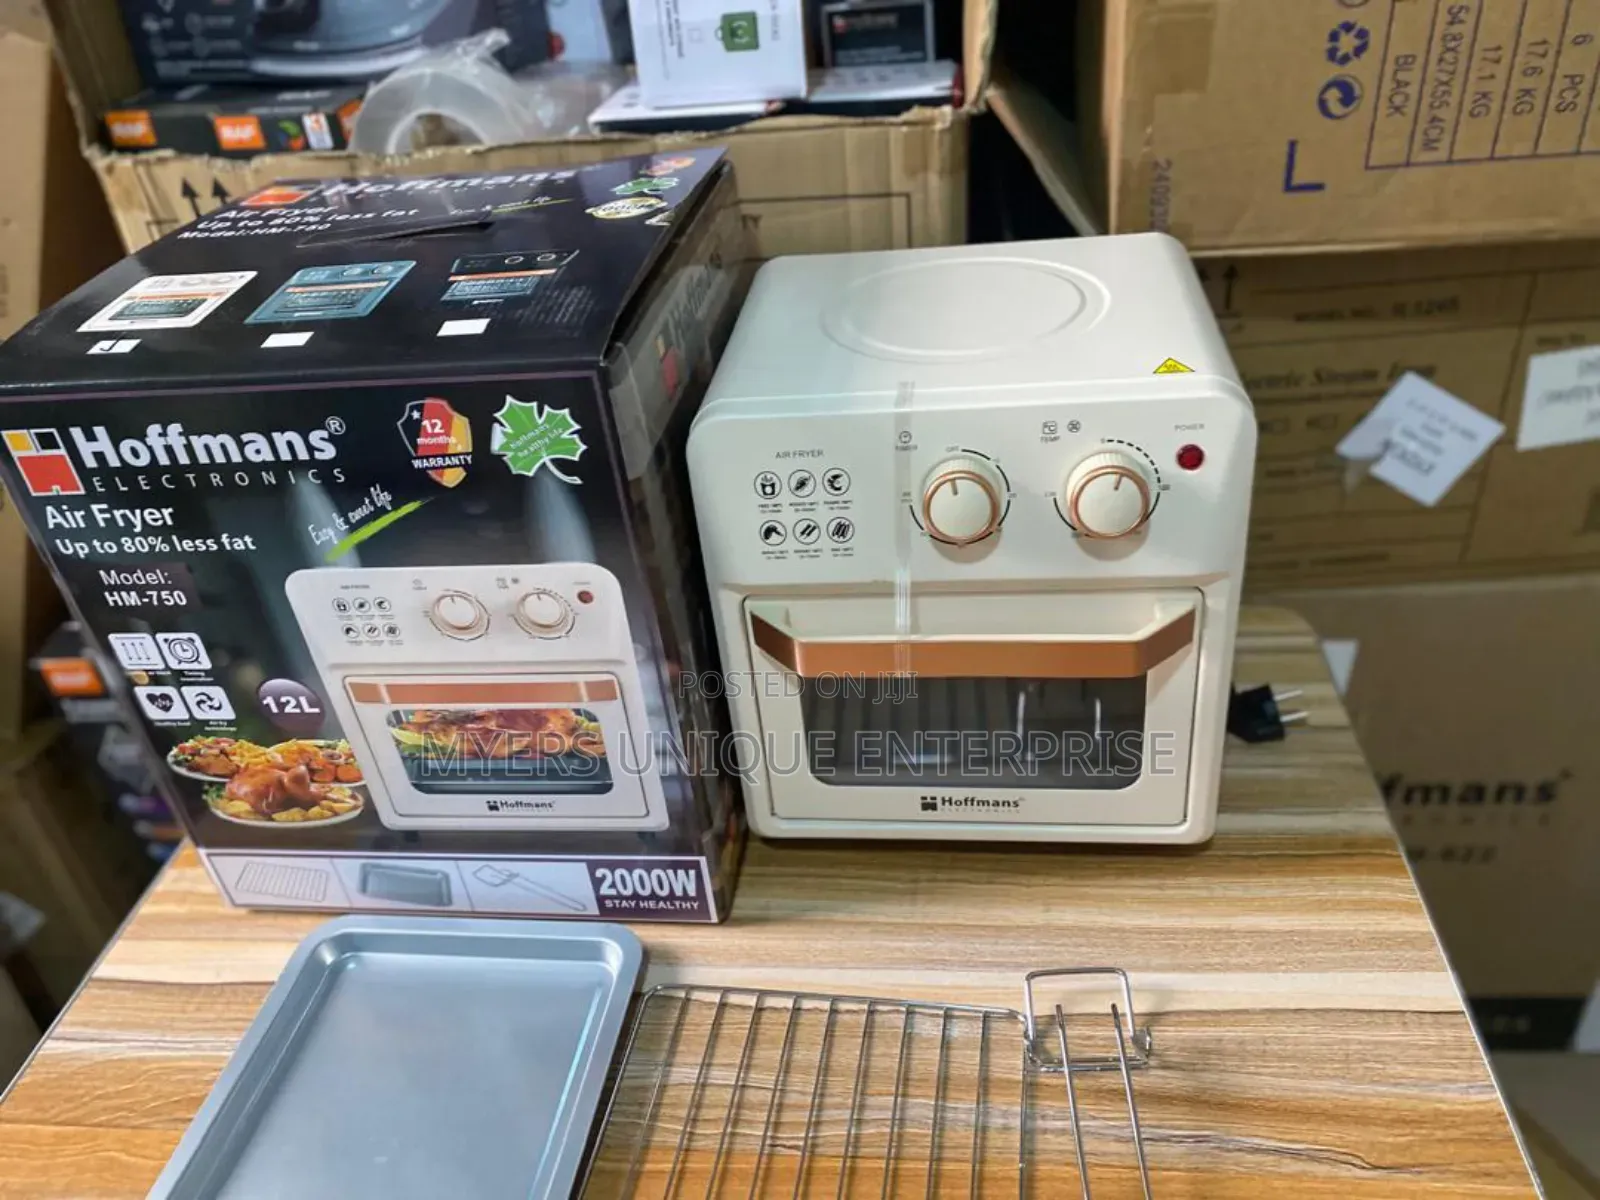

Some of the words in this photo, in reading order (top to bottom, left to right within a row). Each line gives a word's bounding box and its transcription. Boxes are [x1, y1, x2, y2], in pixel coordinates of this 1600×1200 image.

[1572, 33, 1594, 46] 6
[1477, 45, 1503, 80] 17.1
[1522, 38, 1550, 77] 17.6
[1386, 54, 1416, 118] BLACK
[1555, 74, 1585, 113] PCS
[1469, 91, 1494, 118] KG
[1512, 88, 1537, 116] KG
[421, 418, 446, 434] 12
[1174, 423, 1205, 432] POWER
[416, 435, 457, 446] months
[411, 454, 473, 469] WARRANTY
[774, 450, 792, 460] AIR
[793, 449, 825, 459] FRYER
[93, 468, 346, 493] ELECTRONICS
[45, 505, 86, 530] Air
[91, 504, 175, 533] Fryer
[56, 538, 86, 559] Up
[94, 538, 117, 556] to
[120, 536, 171, 555] 80%
[173, 534, 218, 552] less
[220, 533, 257, 552] fat
[99, 569, 173, 587] Model:
[104, 590, 188, 607] HM-750
[263, 695, 321, 715] 12L
[595, 867, 697, 897] 2000W
[604, 899, 637, 909] STAY
[639, 900, 700, 910] HEALTHY
